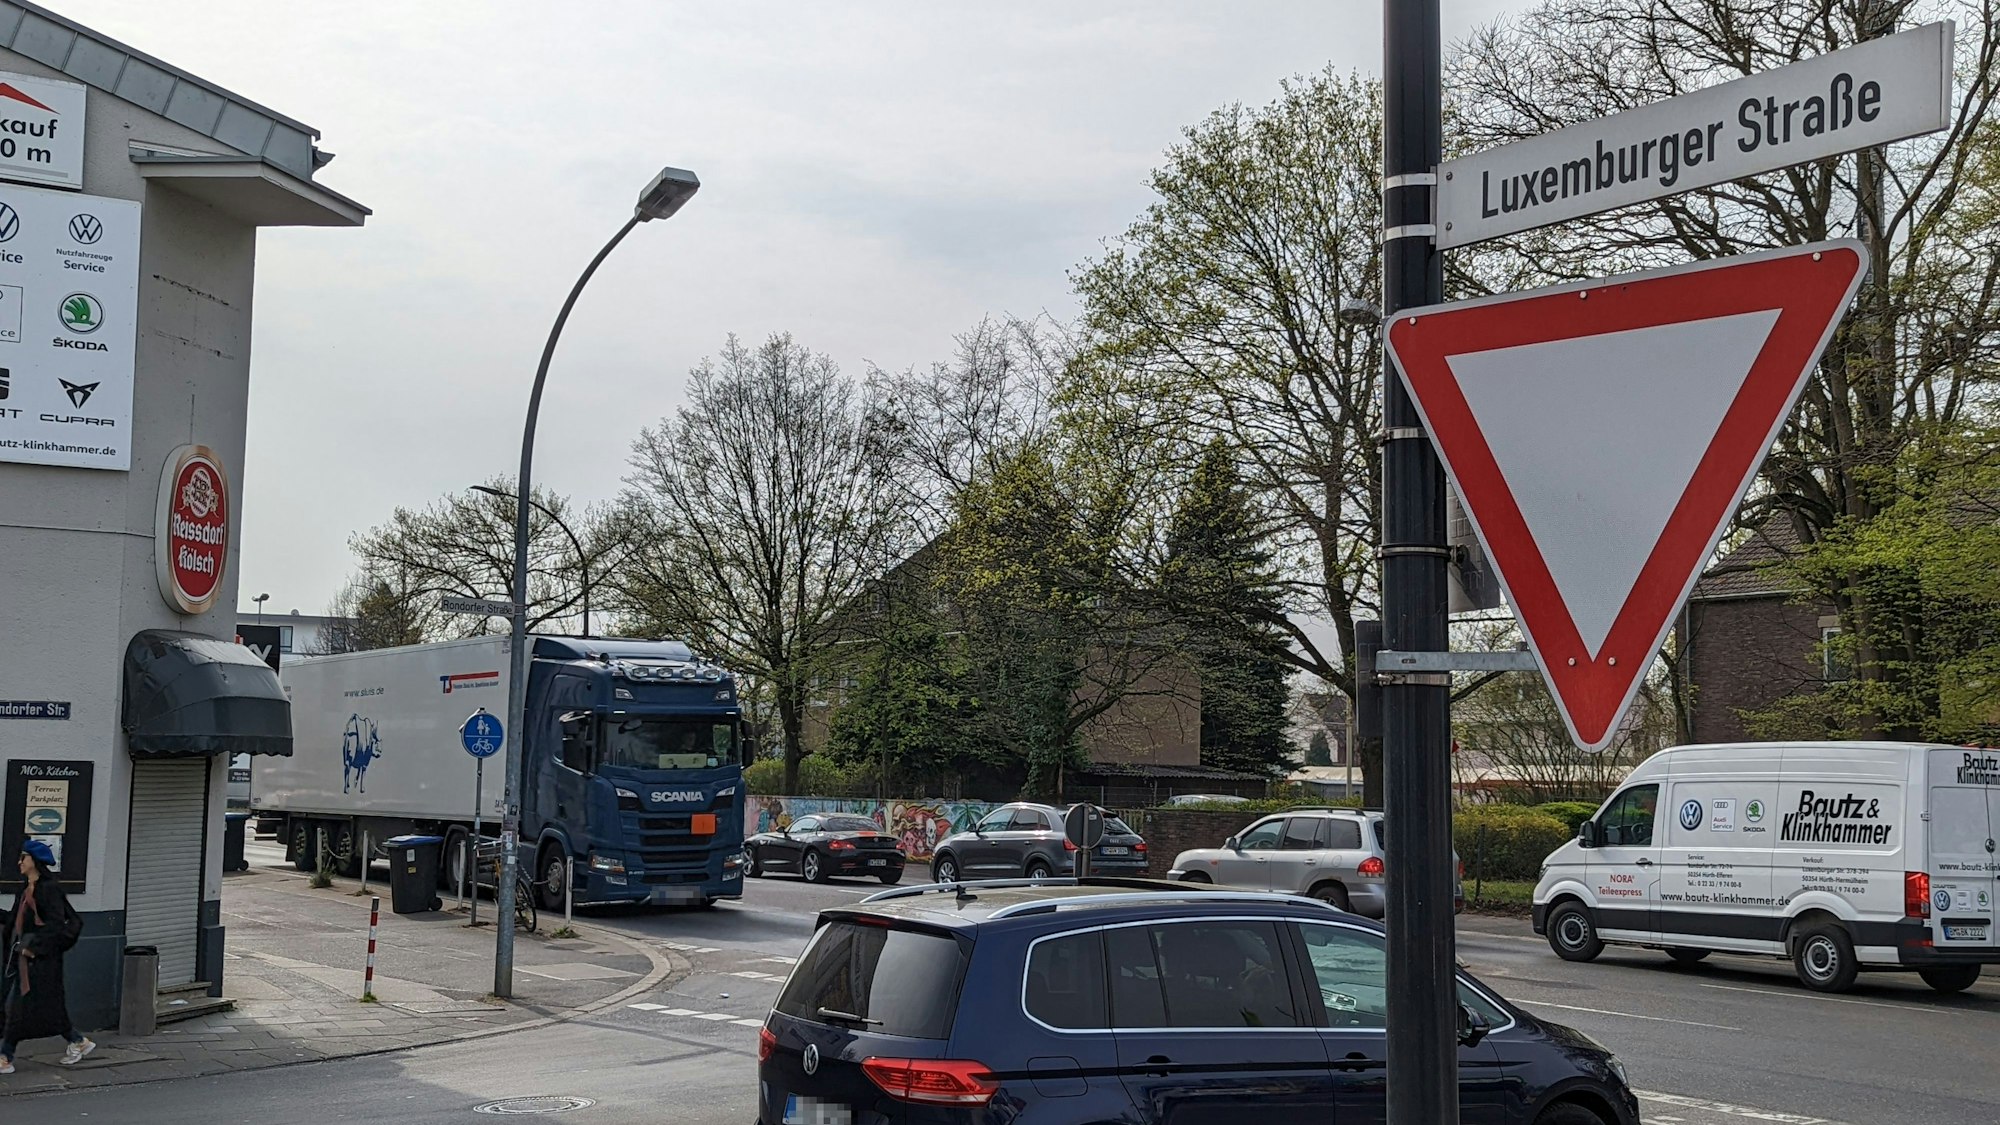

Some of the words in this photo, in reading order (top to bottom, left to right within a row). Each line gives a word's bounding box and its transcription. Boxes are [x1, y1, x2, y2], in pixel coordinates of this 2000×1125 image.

[1480, 120, 1724, 219] Luxemburger
[1737, 72, 1882, 153] Straße
[27, 147, 51, 164] m
[0, 249, 24, 264] ice
[56, 248, 113, 262] Nutzfahrzeuge
[63, 259, 105, 273] Service
[53, 336, 109, 352] ŠKODA
[40, 413, 115, 427] CUPRA
[173, 512, 225, 545] Reissdorf
[178, 544, 215, 578] Kölsch
[443, 599, 485, 612] Rondorfer
[487, 603, 513, 615] Straße
[46, 702, 65, 717] Str.
[1963, 752, 1998, 771] Bautz
[20, 765, 43, 776] MO's
[46, 765, 80, 776] Kitchen
[1957, 766, 2000, 785] Klinkham
[34, 785, 62, 793] Terrace
[651, 791, 705, 803] SCANIA
[1798, 790, 1867, 819] Bautz
[1866, 798, 1880, 819] &
[1780, 811, 1893, 845] Klinkhammer
[1598, 886, 1643, 897] Teileexpress
[1660, 891, 1791, 906] www.bautz-klinkhammer.de
